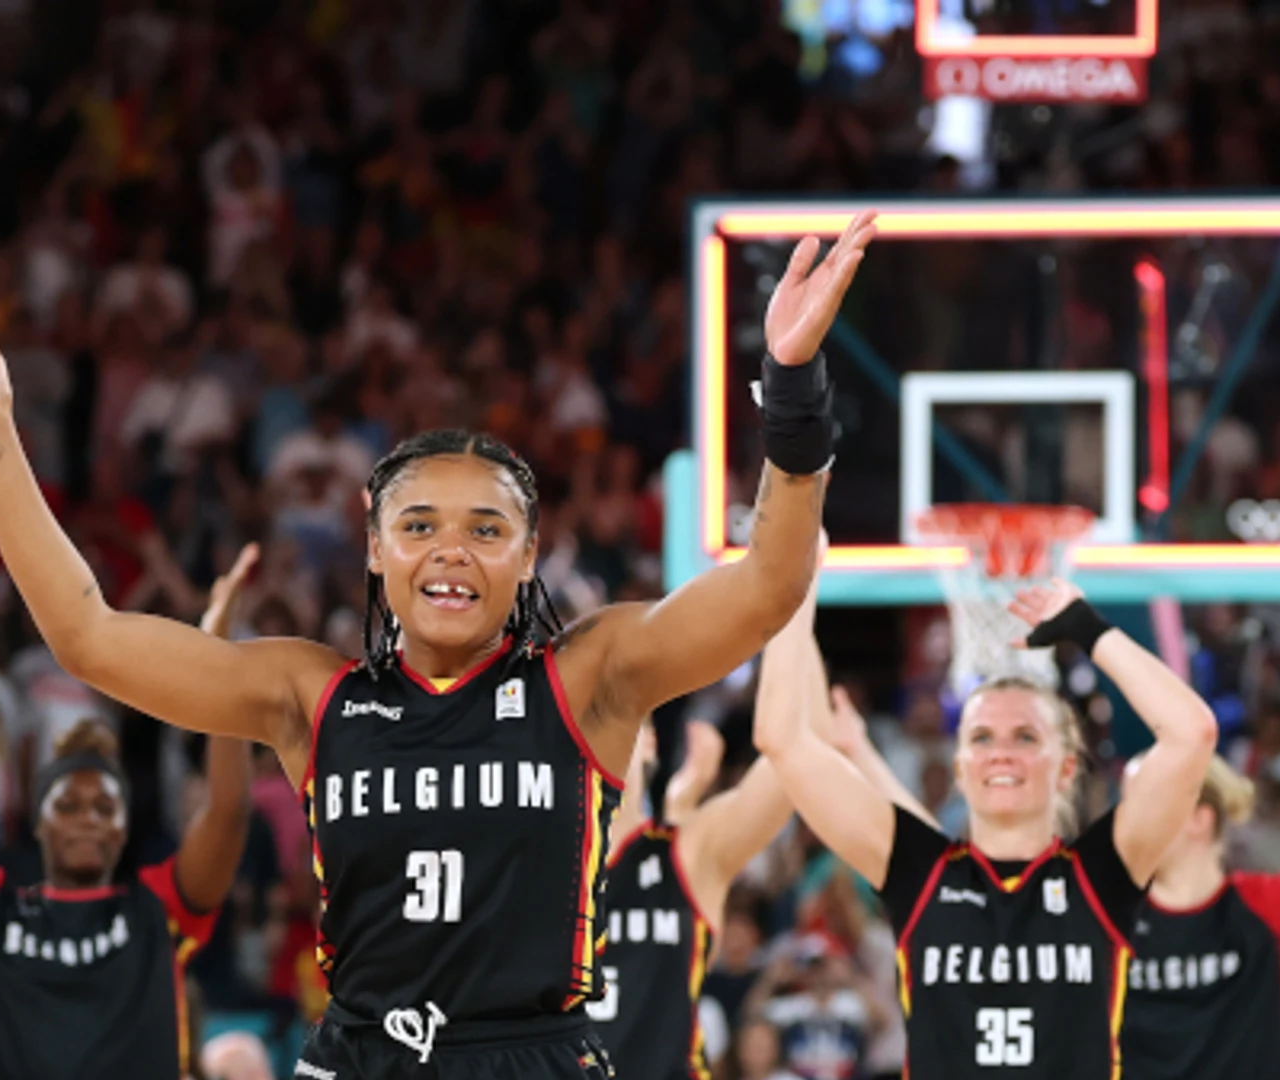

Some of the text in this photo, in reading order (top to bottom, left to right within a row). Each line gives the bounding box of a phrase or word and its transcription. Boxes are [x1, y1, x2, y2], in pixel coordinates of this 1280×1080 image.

[982, 58, 1138, 97] OMEGA
[325, 760, 554, 822] BELGIUM
[402, 849, 464, 923] 31
[922, 943, 1093, 986] BELGIUM
[975, 1007, 1035, 1067] 35
